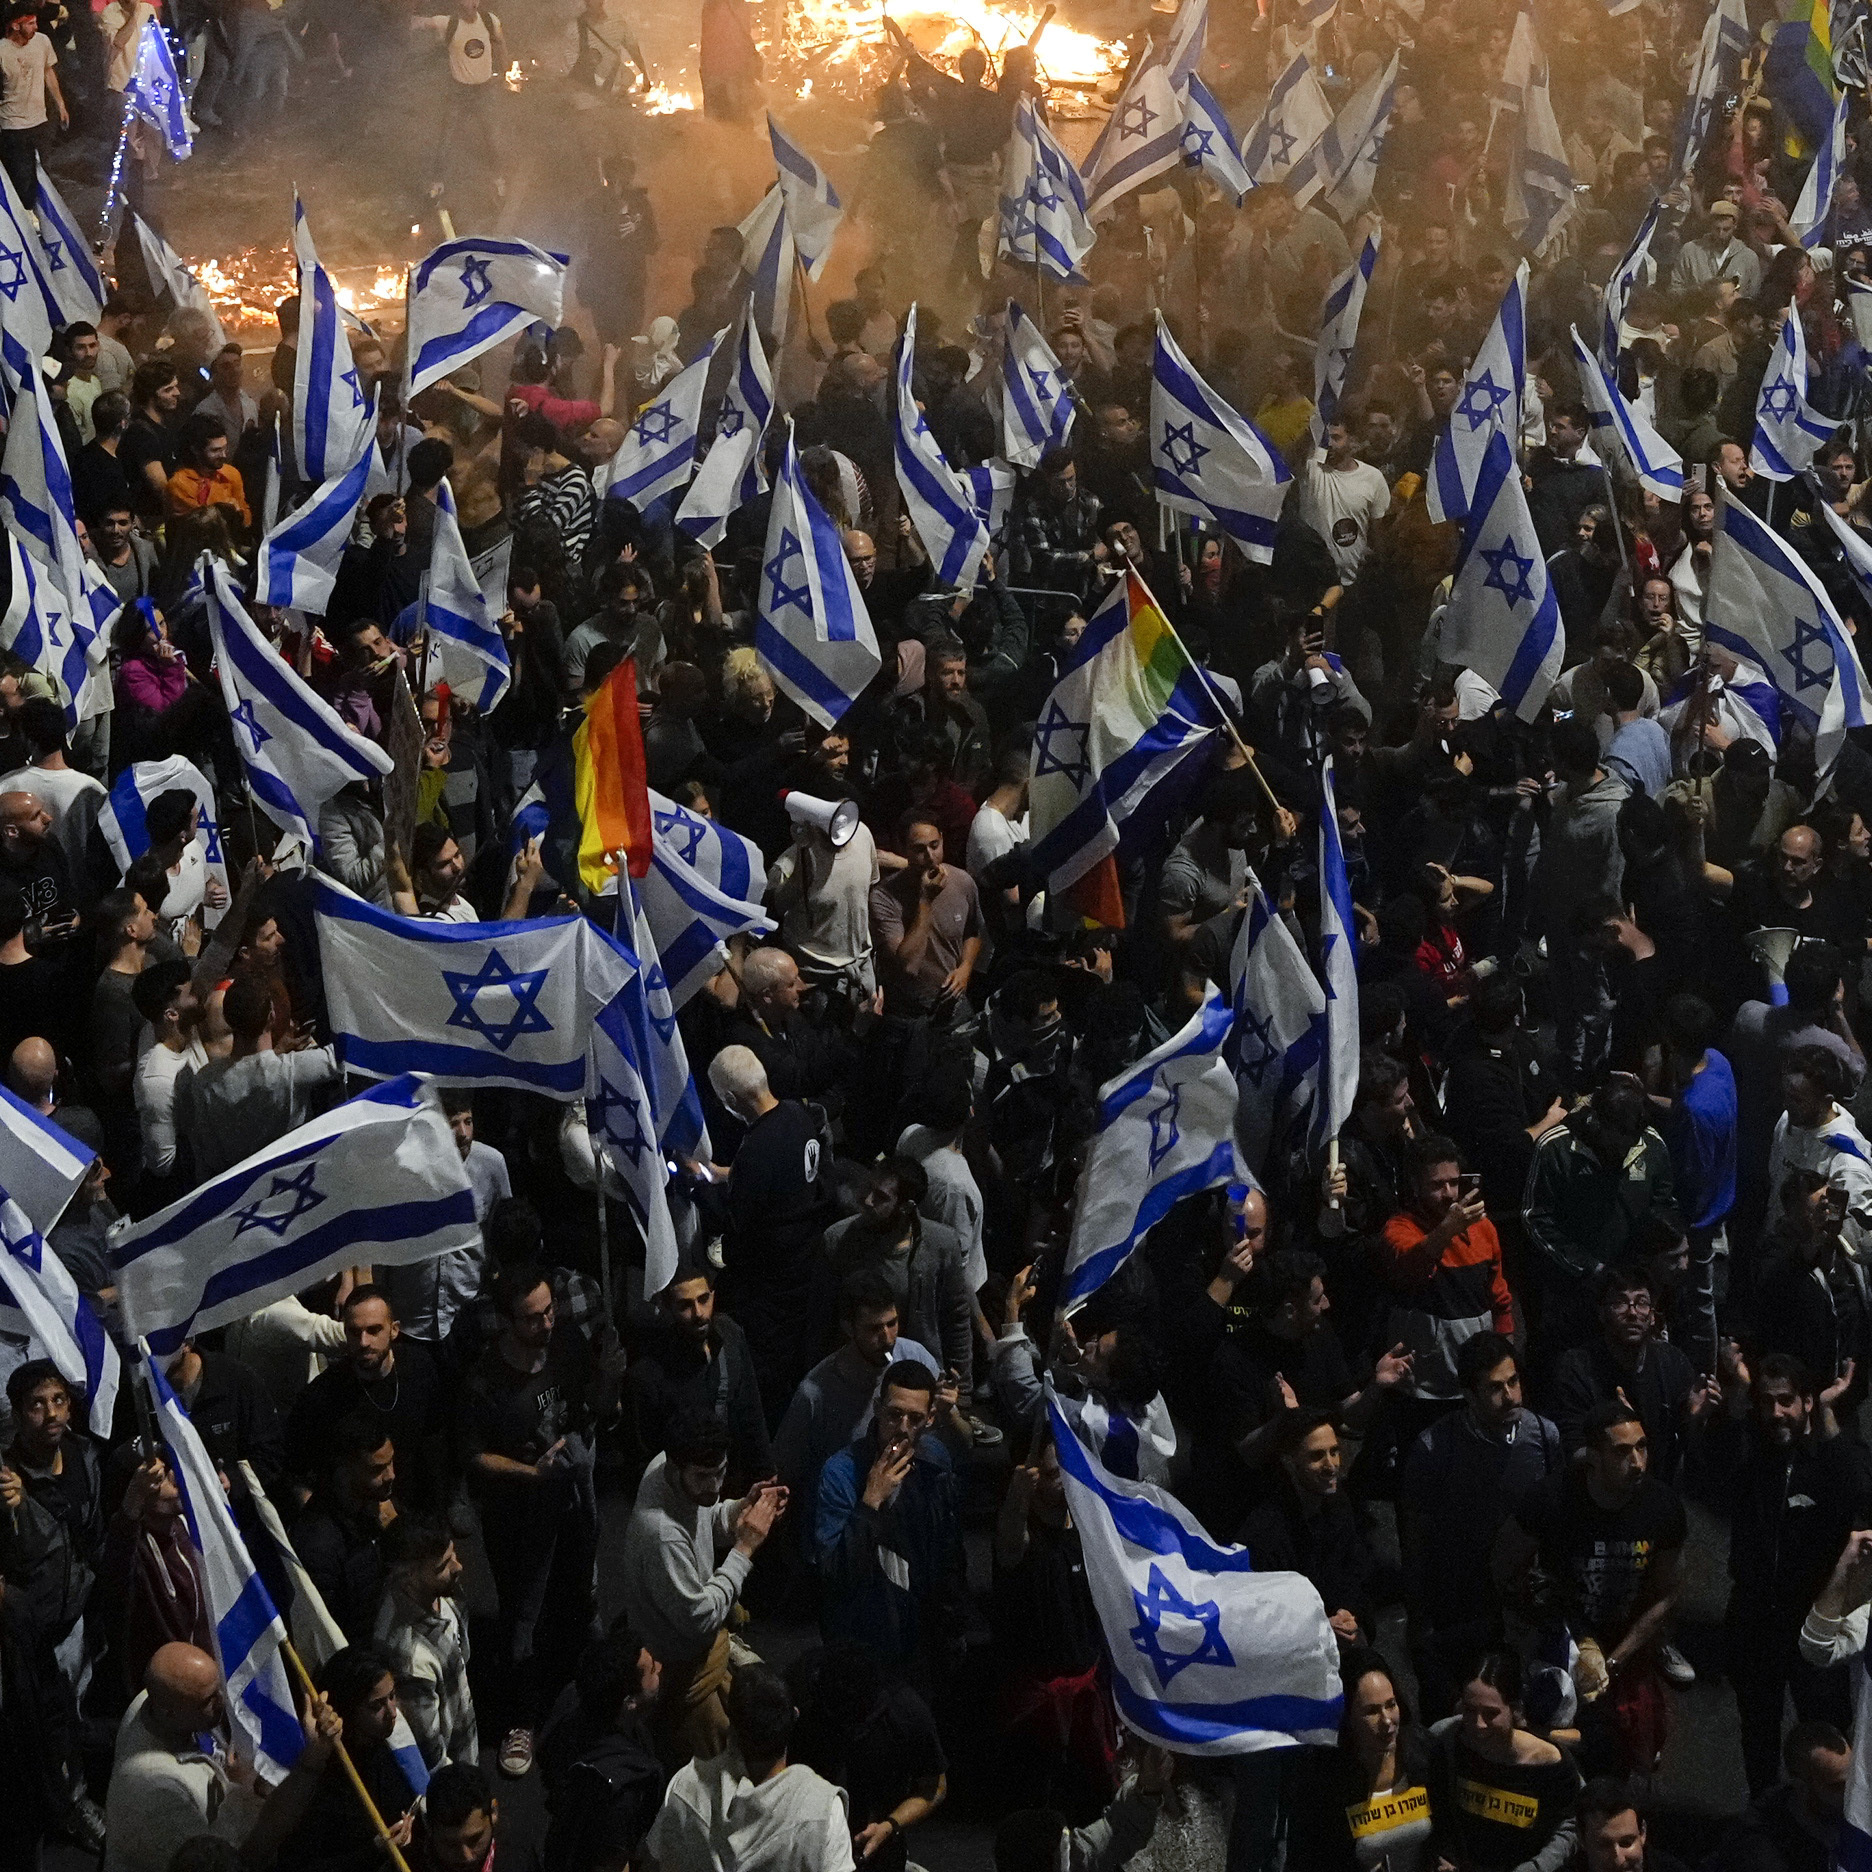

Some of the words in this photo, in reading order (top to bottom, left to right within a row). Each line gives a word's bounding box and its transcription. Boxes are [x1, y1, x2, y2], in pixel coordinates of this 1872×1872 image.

[536, 1384, 560, 1411] JERRY
[1384, 1802, 1397, 1819] בן
[1398, 1793, 1427, 1813] שקרן
[1488, 1796, 1501, 1810] בן
[1504, 1800, 1535, 1819] שקרן
[1352, 1807, 1382, 1827] שקרן
